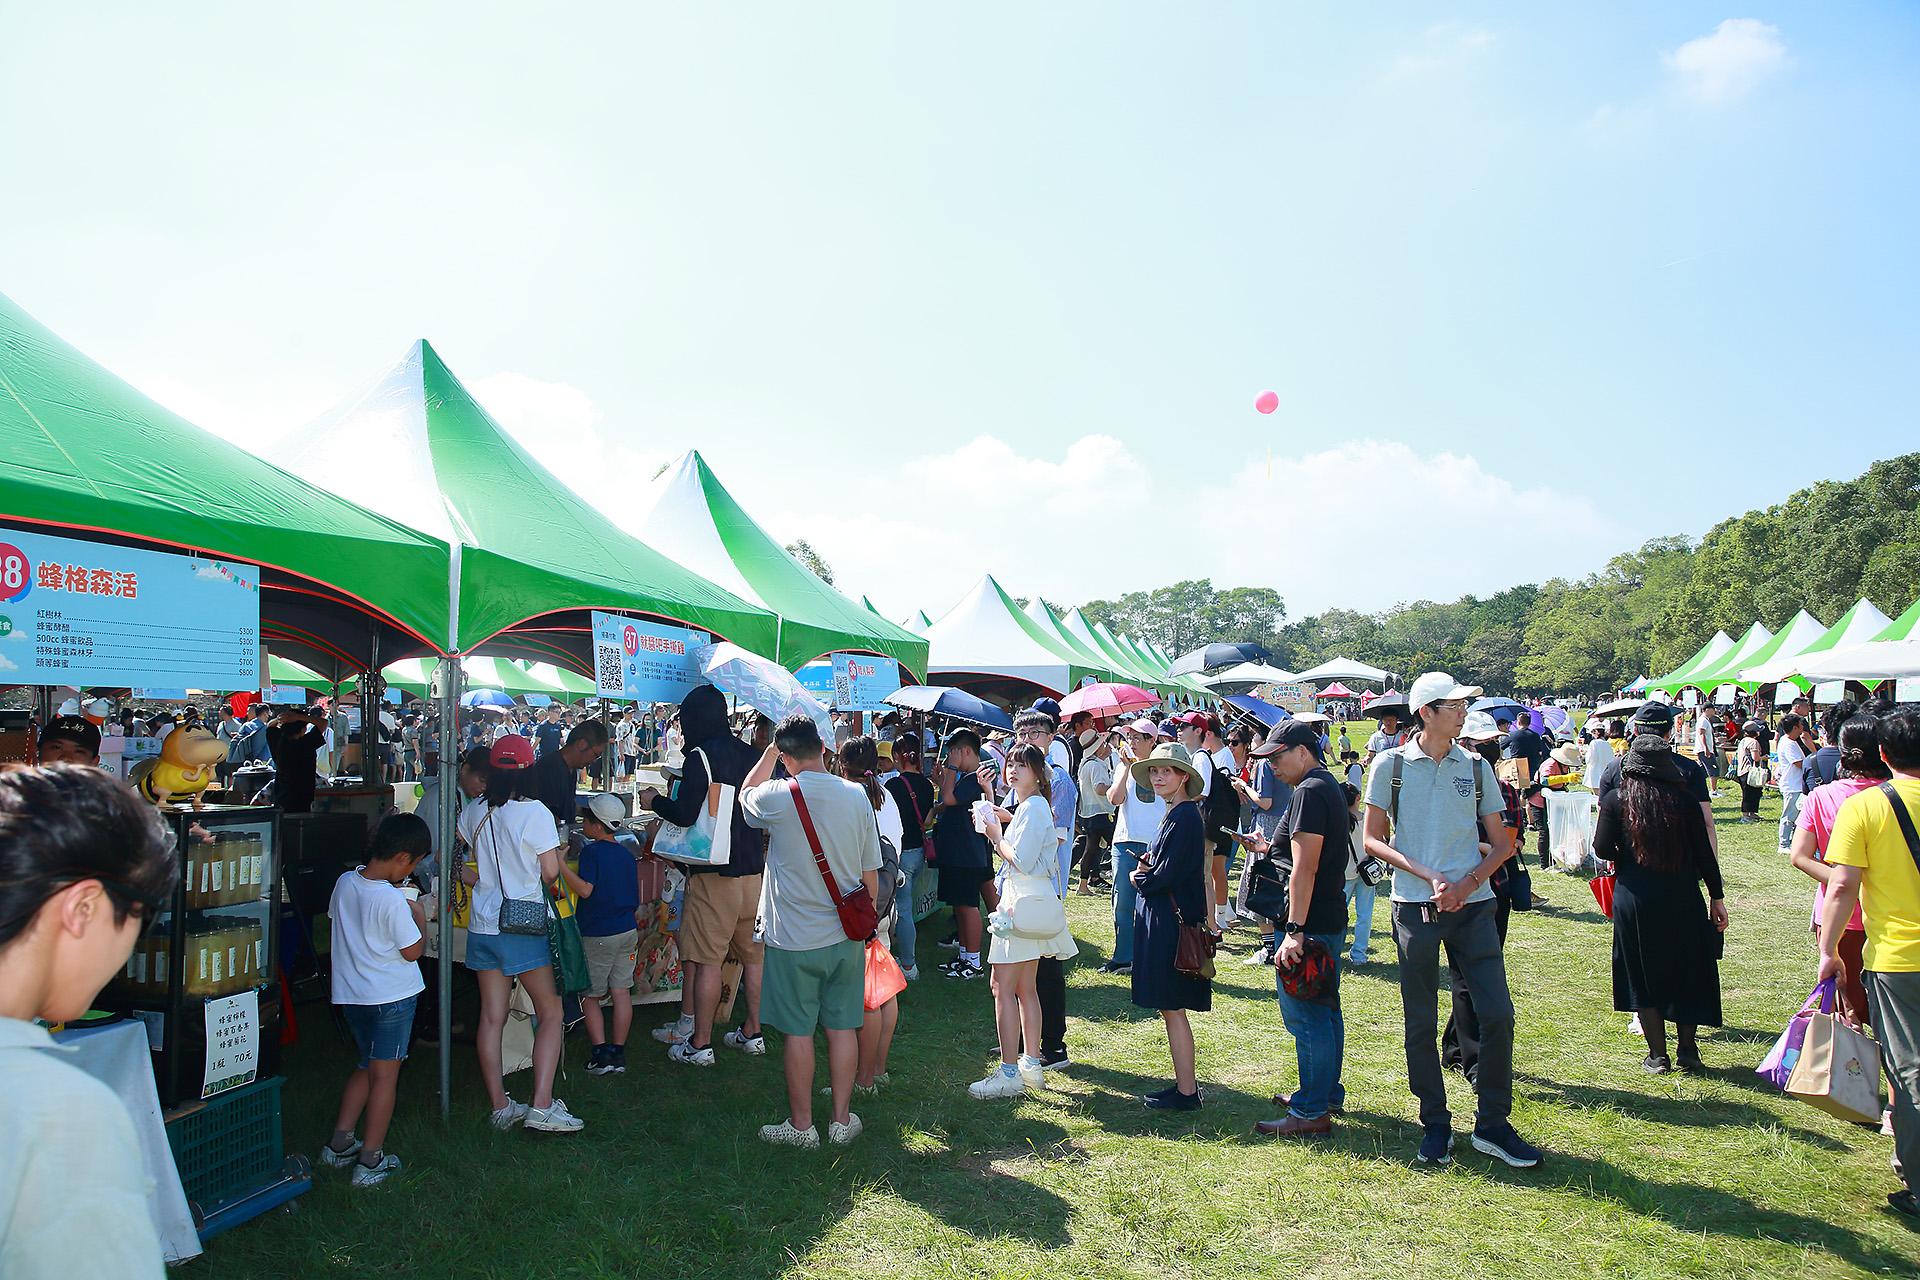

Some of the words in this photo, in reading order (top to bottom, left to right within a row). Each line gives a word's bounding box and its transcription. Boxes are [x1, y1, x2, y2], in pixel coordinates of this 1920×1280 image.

[0, 556, 22, 588] 8
[37, 560, 138, 599] 蜂格森活
[36, 609, 63, 620] 紅樹林
[36, 634, 59, 644] 500cc
[61, 635, 94, 647] 蜂蜜飲品
[625, 630, 637, 650] 37
[234, 1049, 253, 1064] 70元
